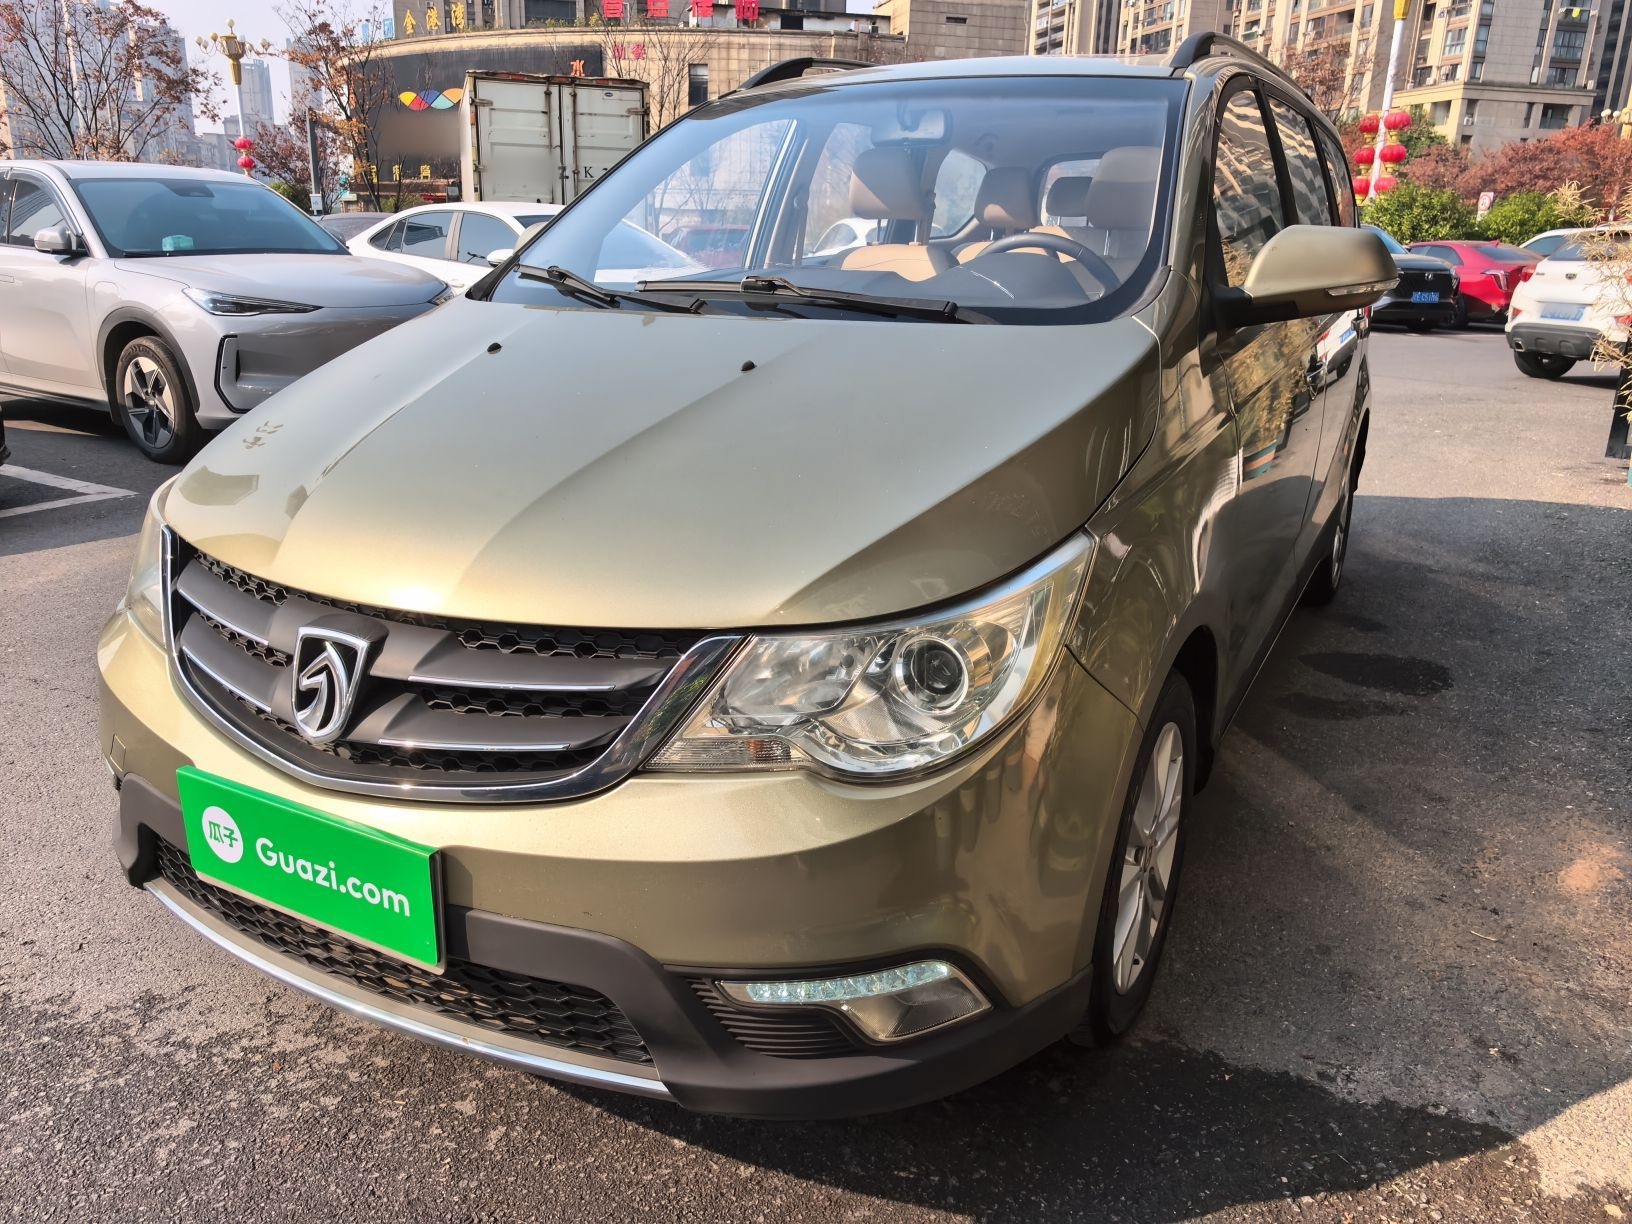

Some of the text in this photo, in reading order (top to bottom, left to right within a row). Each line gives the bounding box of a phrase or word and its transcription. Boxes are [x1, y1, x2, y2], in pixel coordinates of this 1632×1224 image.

[403, 2, 465, 35] 金港湾
[208, 820, 239, 849] 瓜子
[255, 837, 411, 918] Guazi.com
